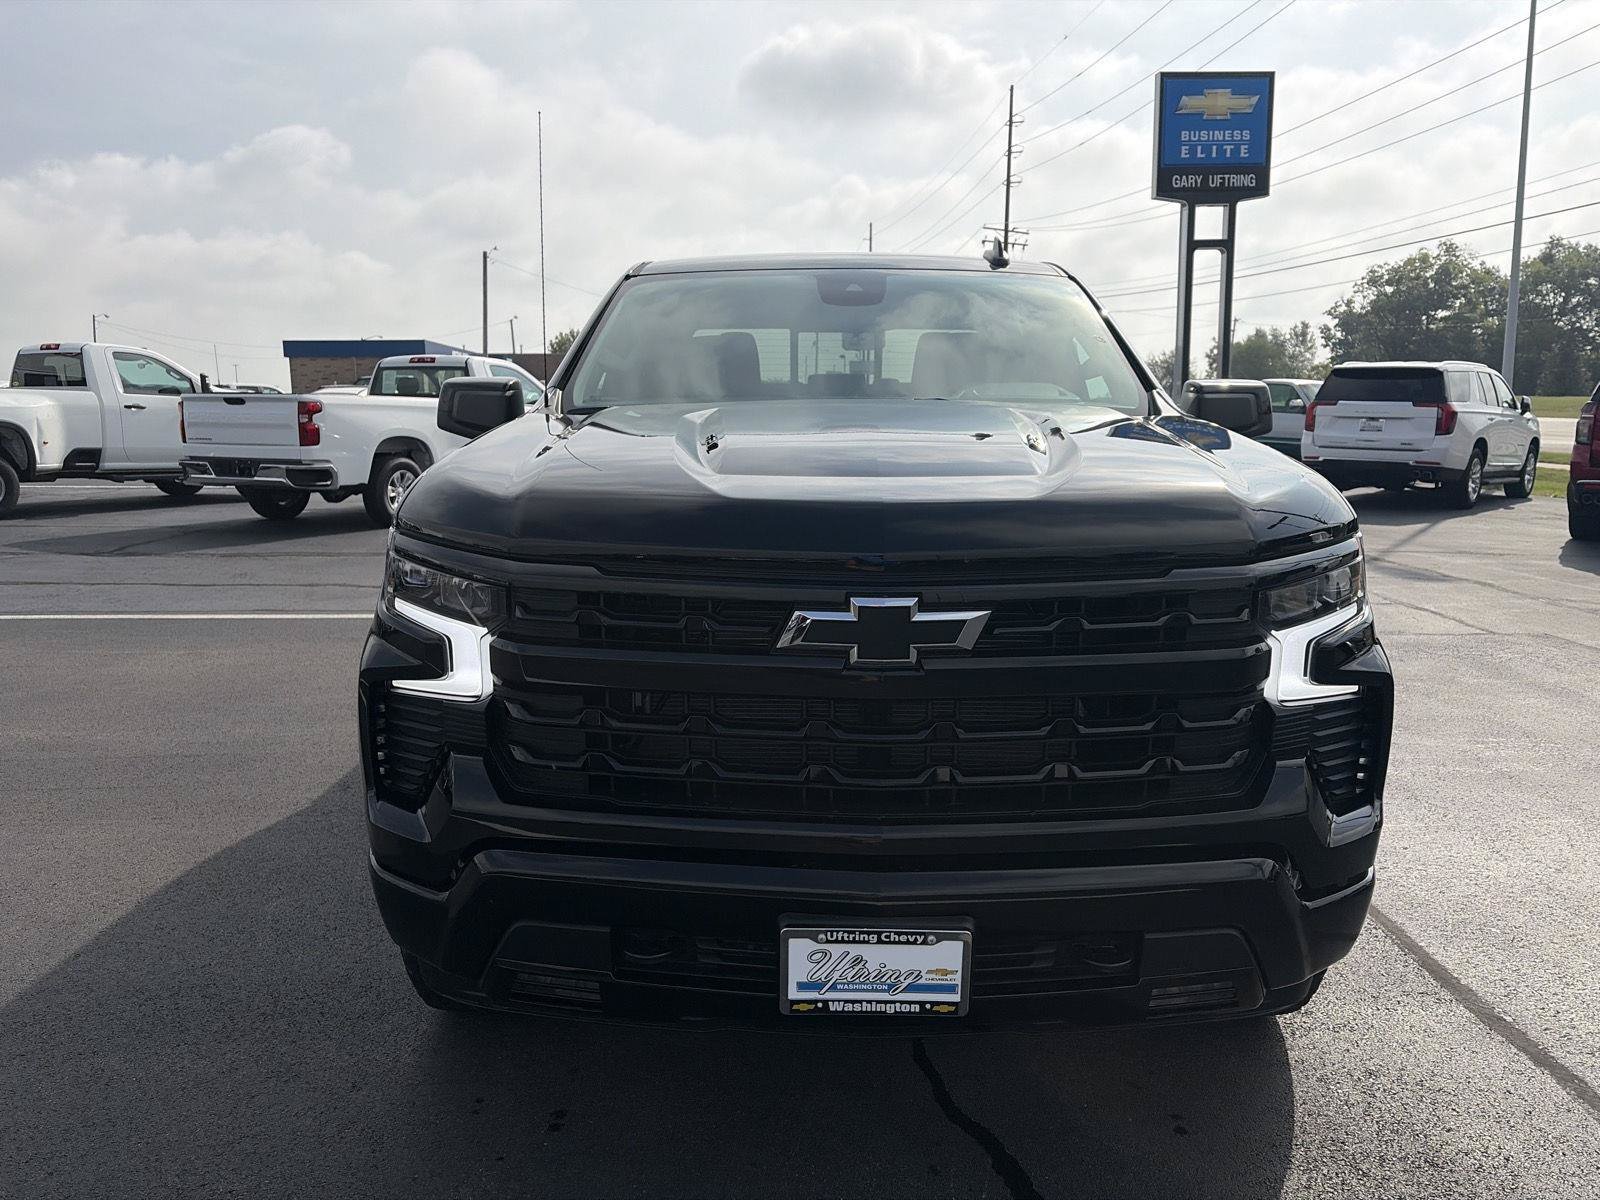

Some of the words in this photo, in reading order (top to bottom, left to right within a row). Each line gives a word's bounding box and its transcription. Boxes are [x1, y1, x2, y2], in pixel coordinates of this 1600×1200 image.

[1181, 130, 1250, 141] BUSINESS
[1181, 145, 1249, 158] ELITE
[1172, 174, 1203, 188] GARY
[1208, 173, 1256, 187] UFTRING
[826, 931, 878, 943] Uftring
[880, 932, 925, 944] Chevy
[806, 948, 923, 996] Uftring
[829, 1001, 920, 1013] Washington
